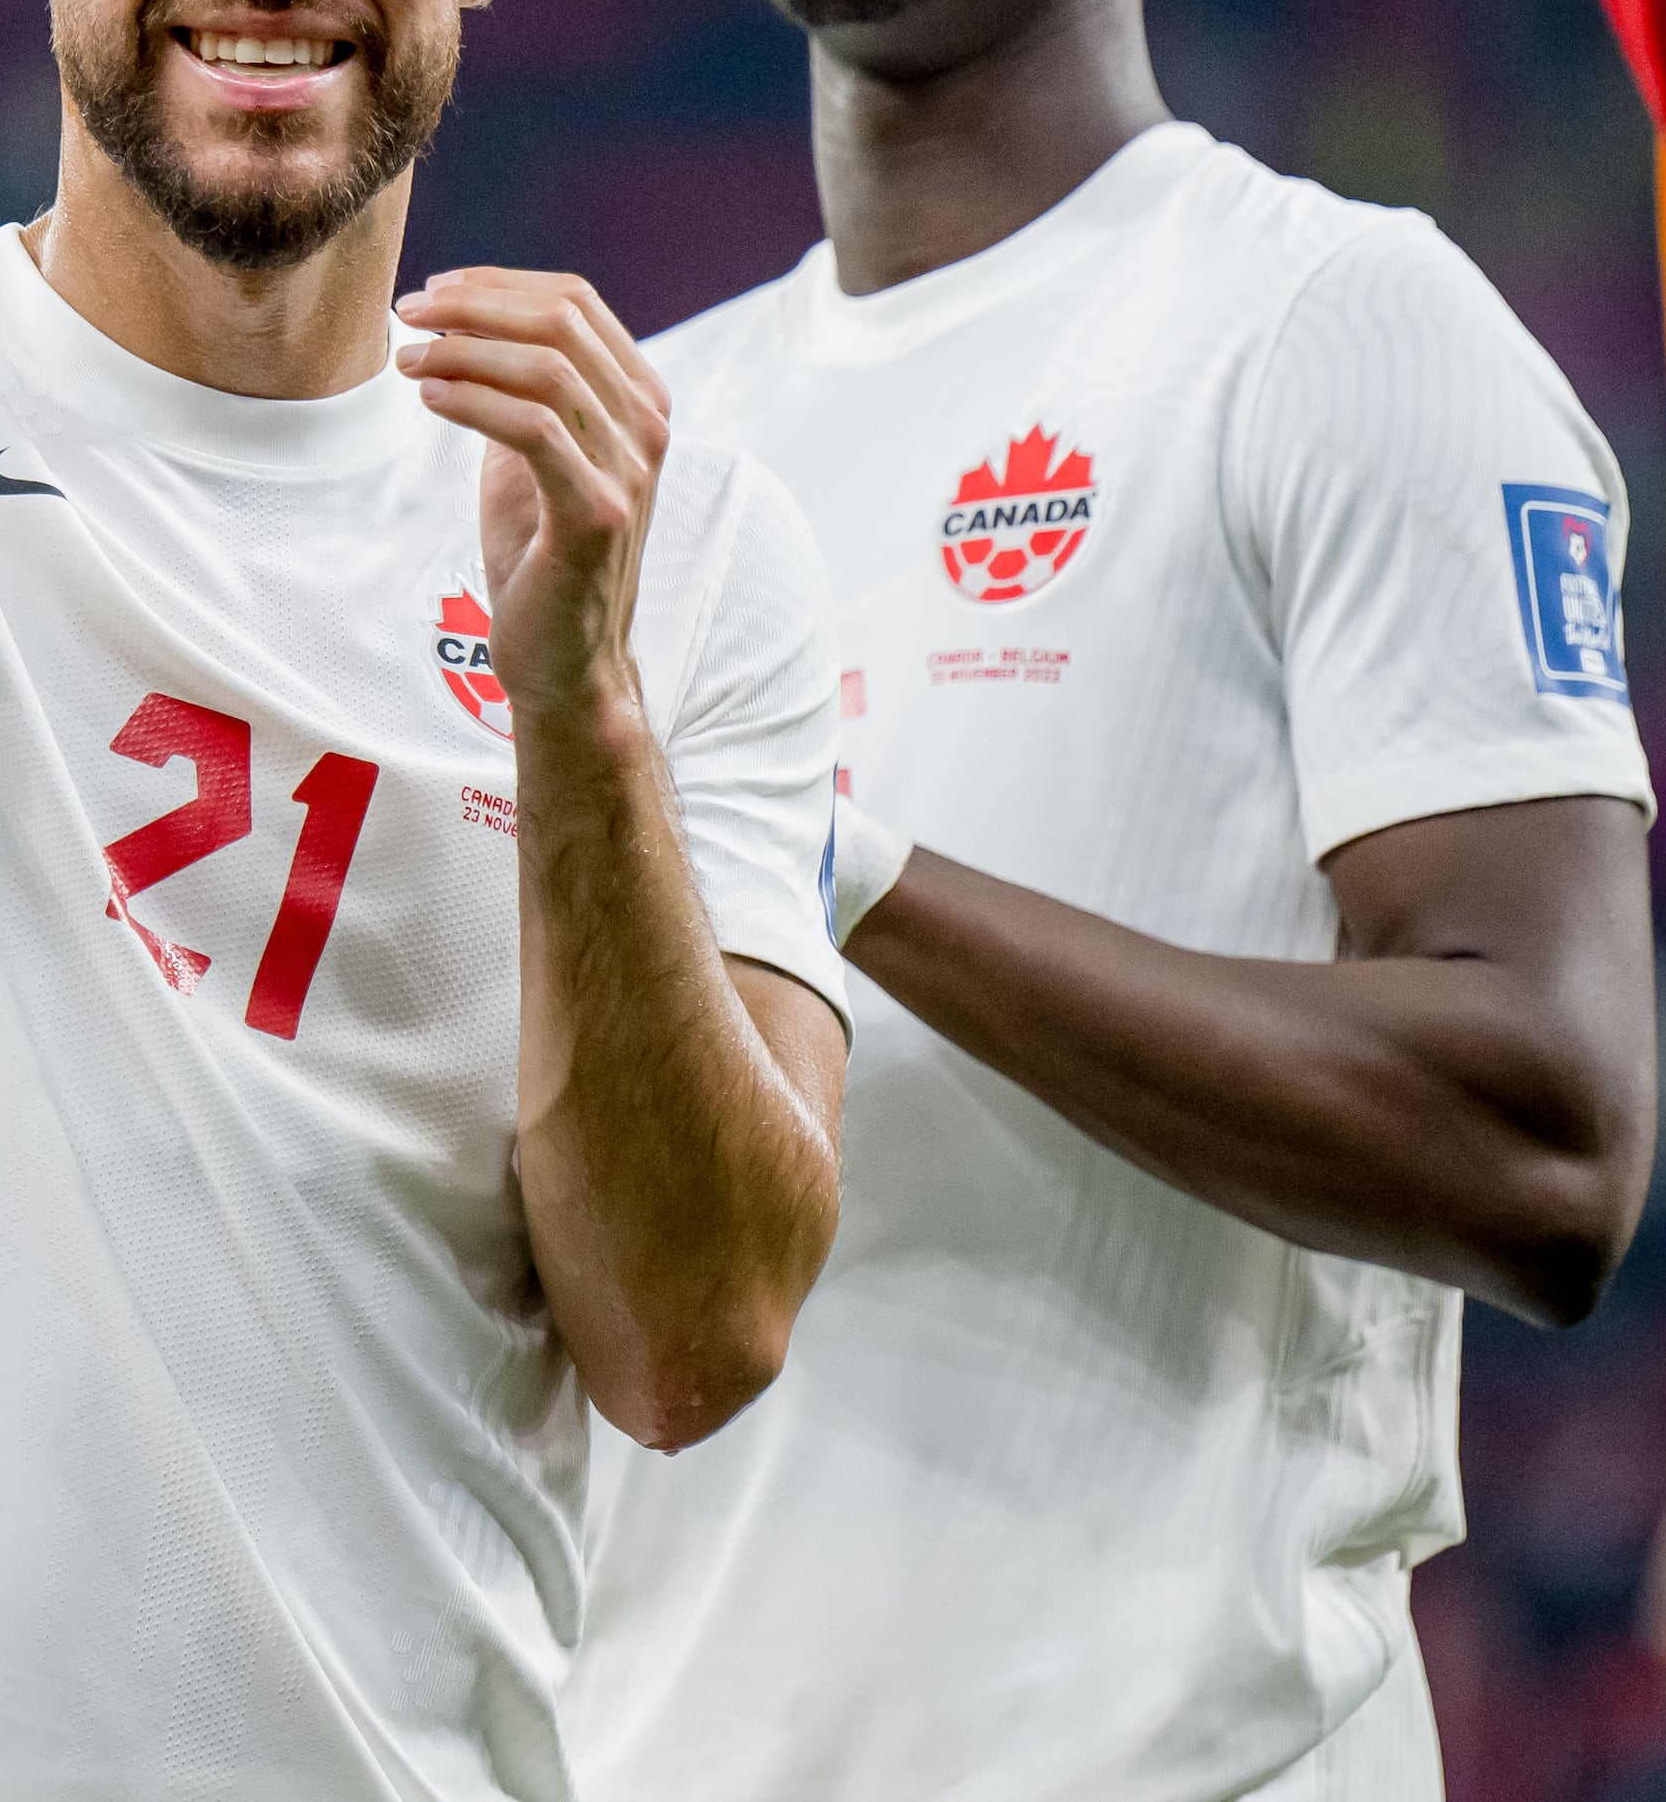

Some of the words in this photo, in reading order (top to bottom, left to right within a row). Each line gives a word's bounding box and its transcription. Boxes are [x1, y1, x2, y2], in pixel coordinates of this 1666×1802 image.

[943, 496, 1090, 537] CANADA
[463, 806, 480, 823] 23
[103, 692, 380, 1040] 21
